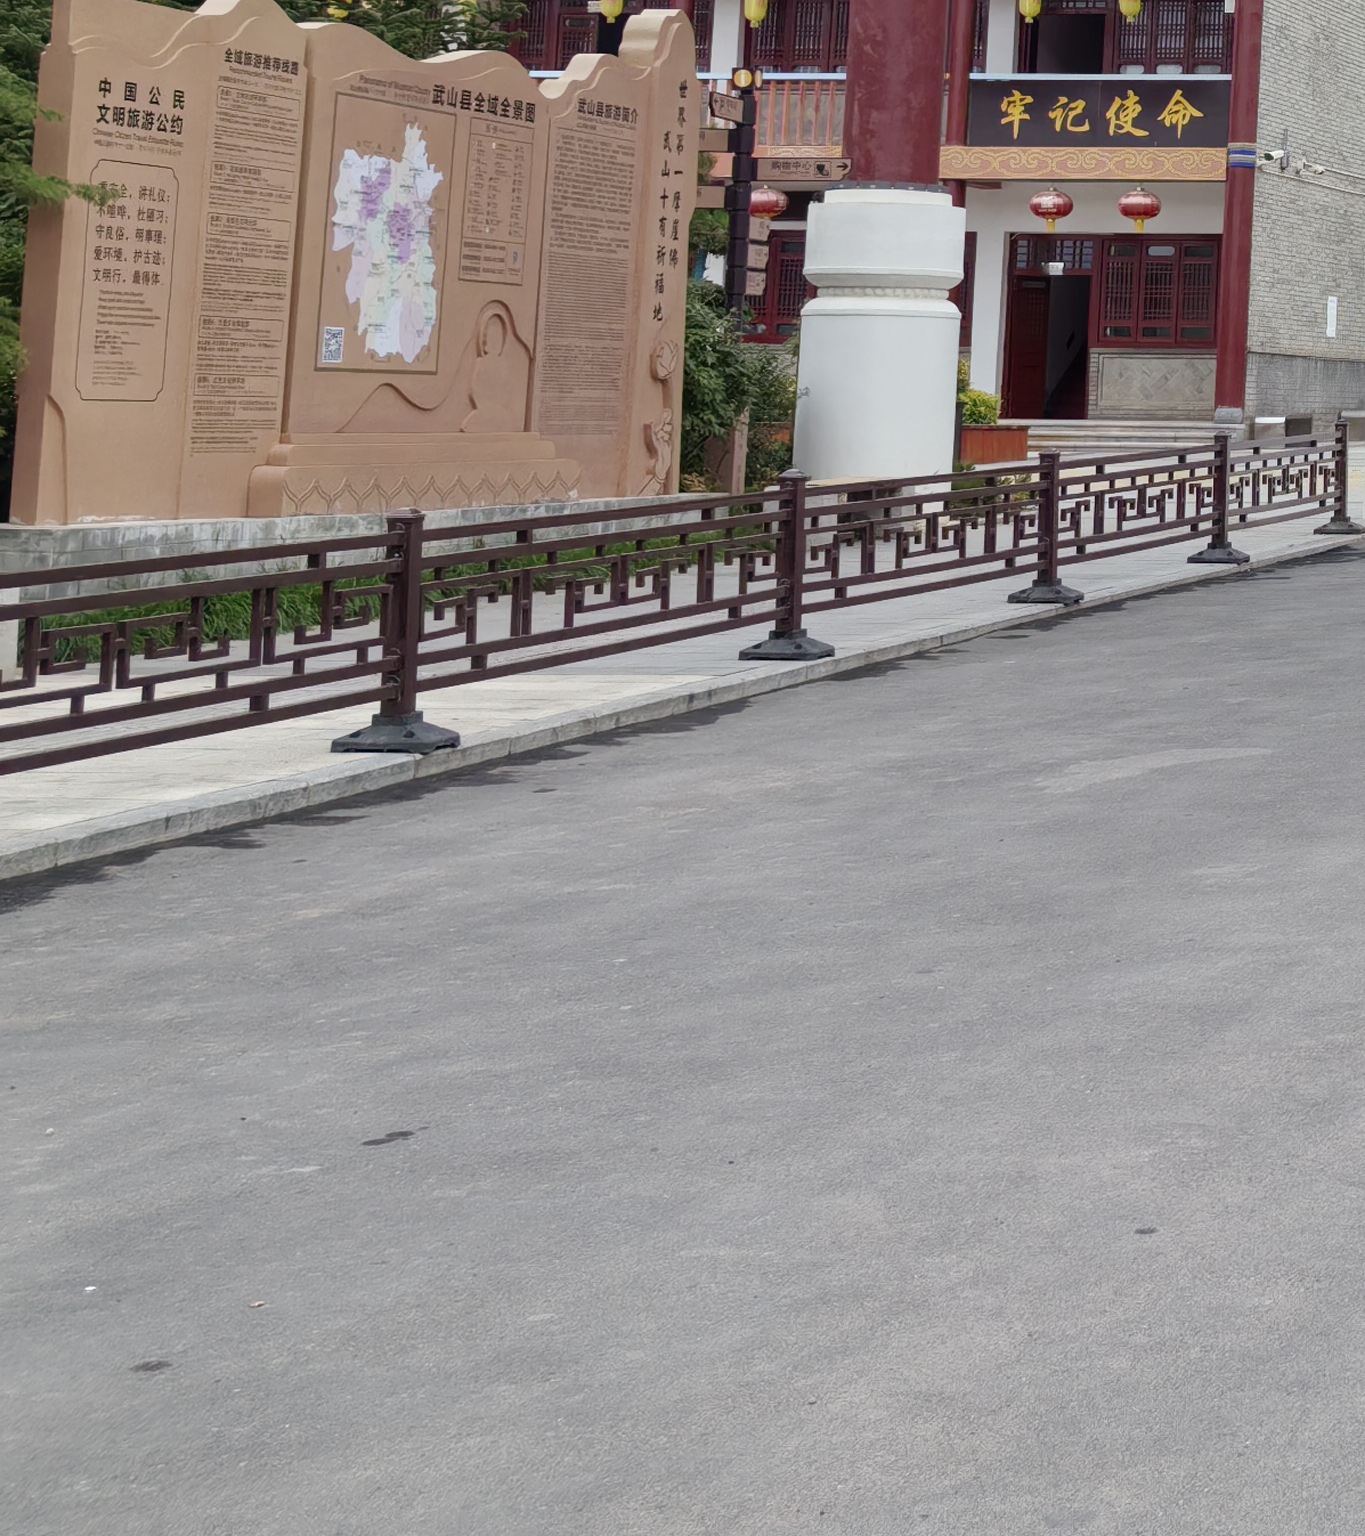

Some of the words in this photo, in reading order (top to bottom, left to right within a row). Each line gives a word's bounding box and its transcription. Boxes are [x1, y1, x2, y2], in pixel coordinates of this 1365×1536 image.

[98, 77, 185, 110] 中国公民
[432, 84, 536, 124] 武山县全域全景图
[96, 103, 184, 135] 文明旅游公约
[1000, 89, 1204, 140] 牢记使命
